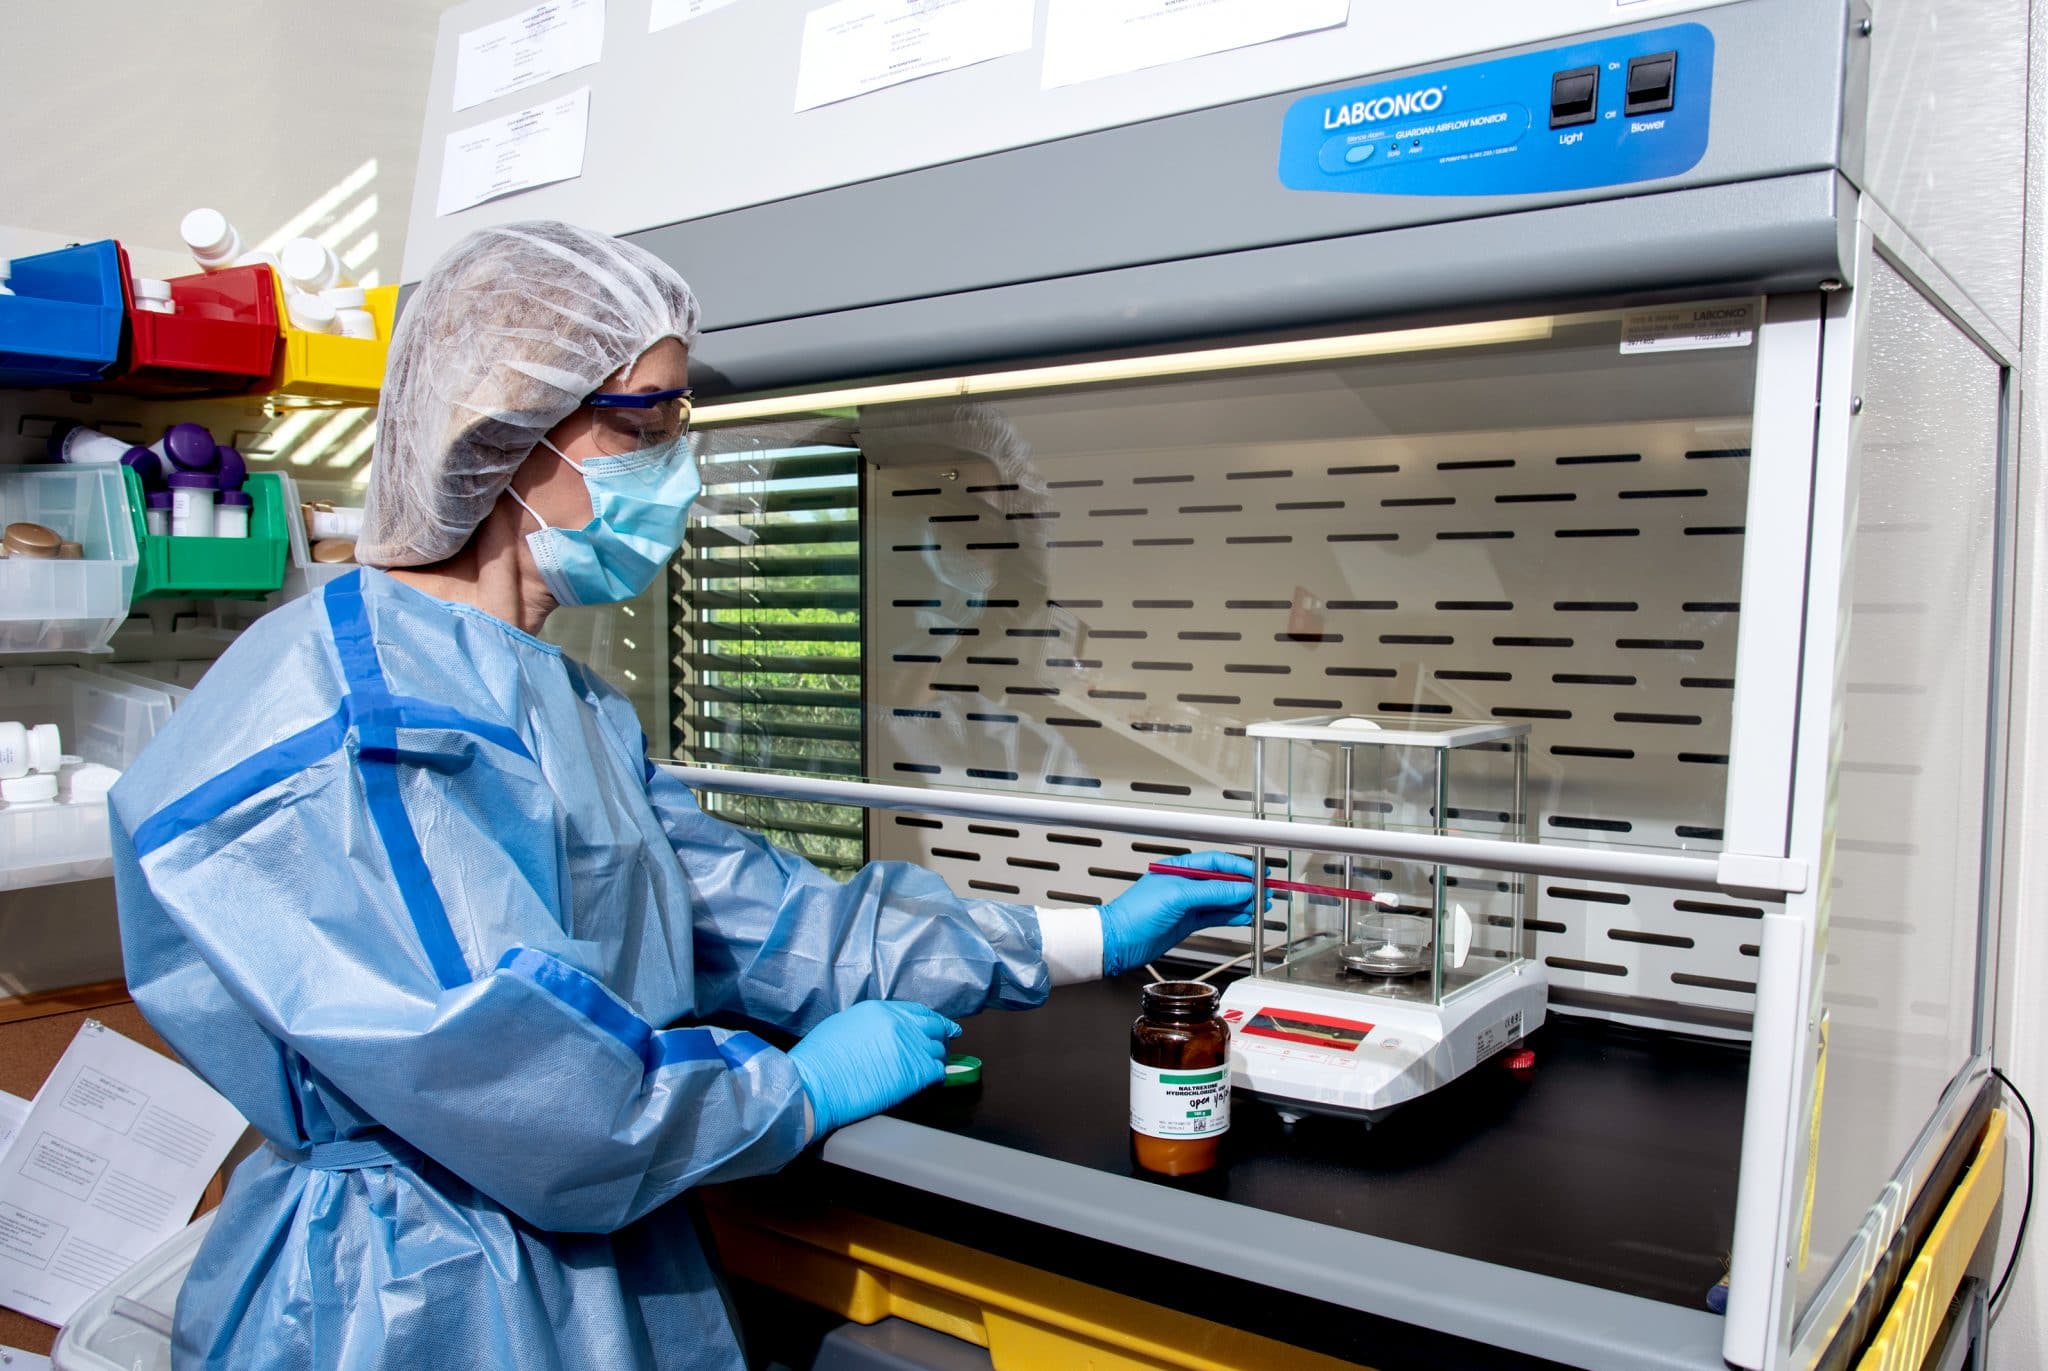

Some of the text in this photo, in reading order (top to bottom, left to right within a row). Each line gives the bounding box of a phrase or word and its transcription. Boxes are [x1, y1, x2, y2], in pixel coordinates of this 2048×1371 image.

[1608, 62, 1621, 71] On
[1324, 87, 1442, 129] LABCONCO
[1604, 110, 1617, 119] Off
[1395, 112, 1507, 139] GUARDIAN AIRFLOW MONITOR
[1631, 119, 1665, 133] Blower
[1559, 131, 1584, 146] Light
